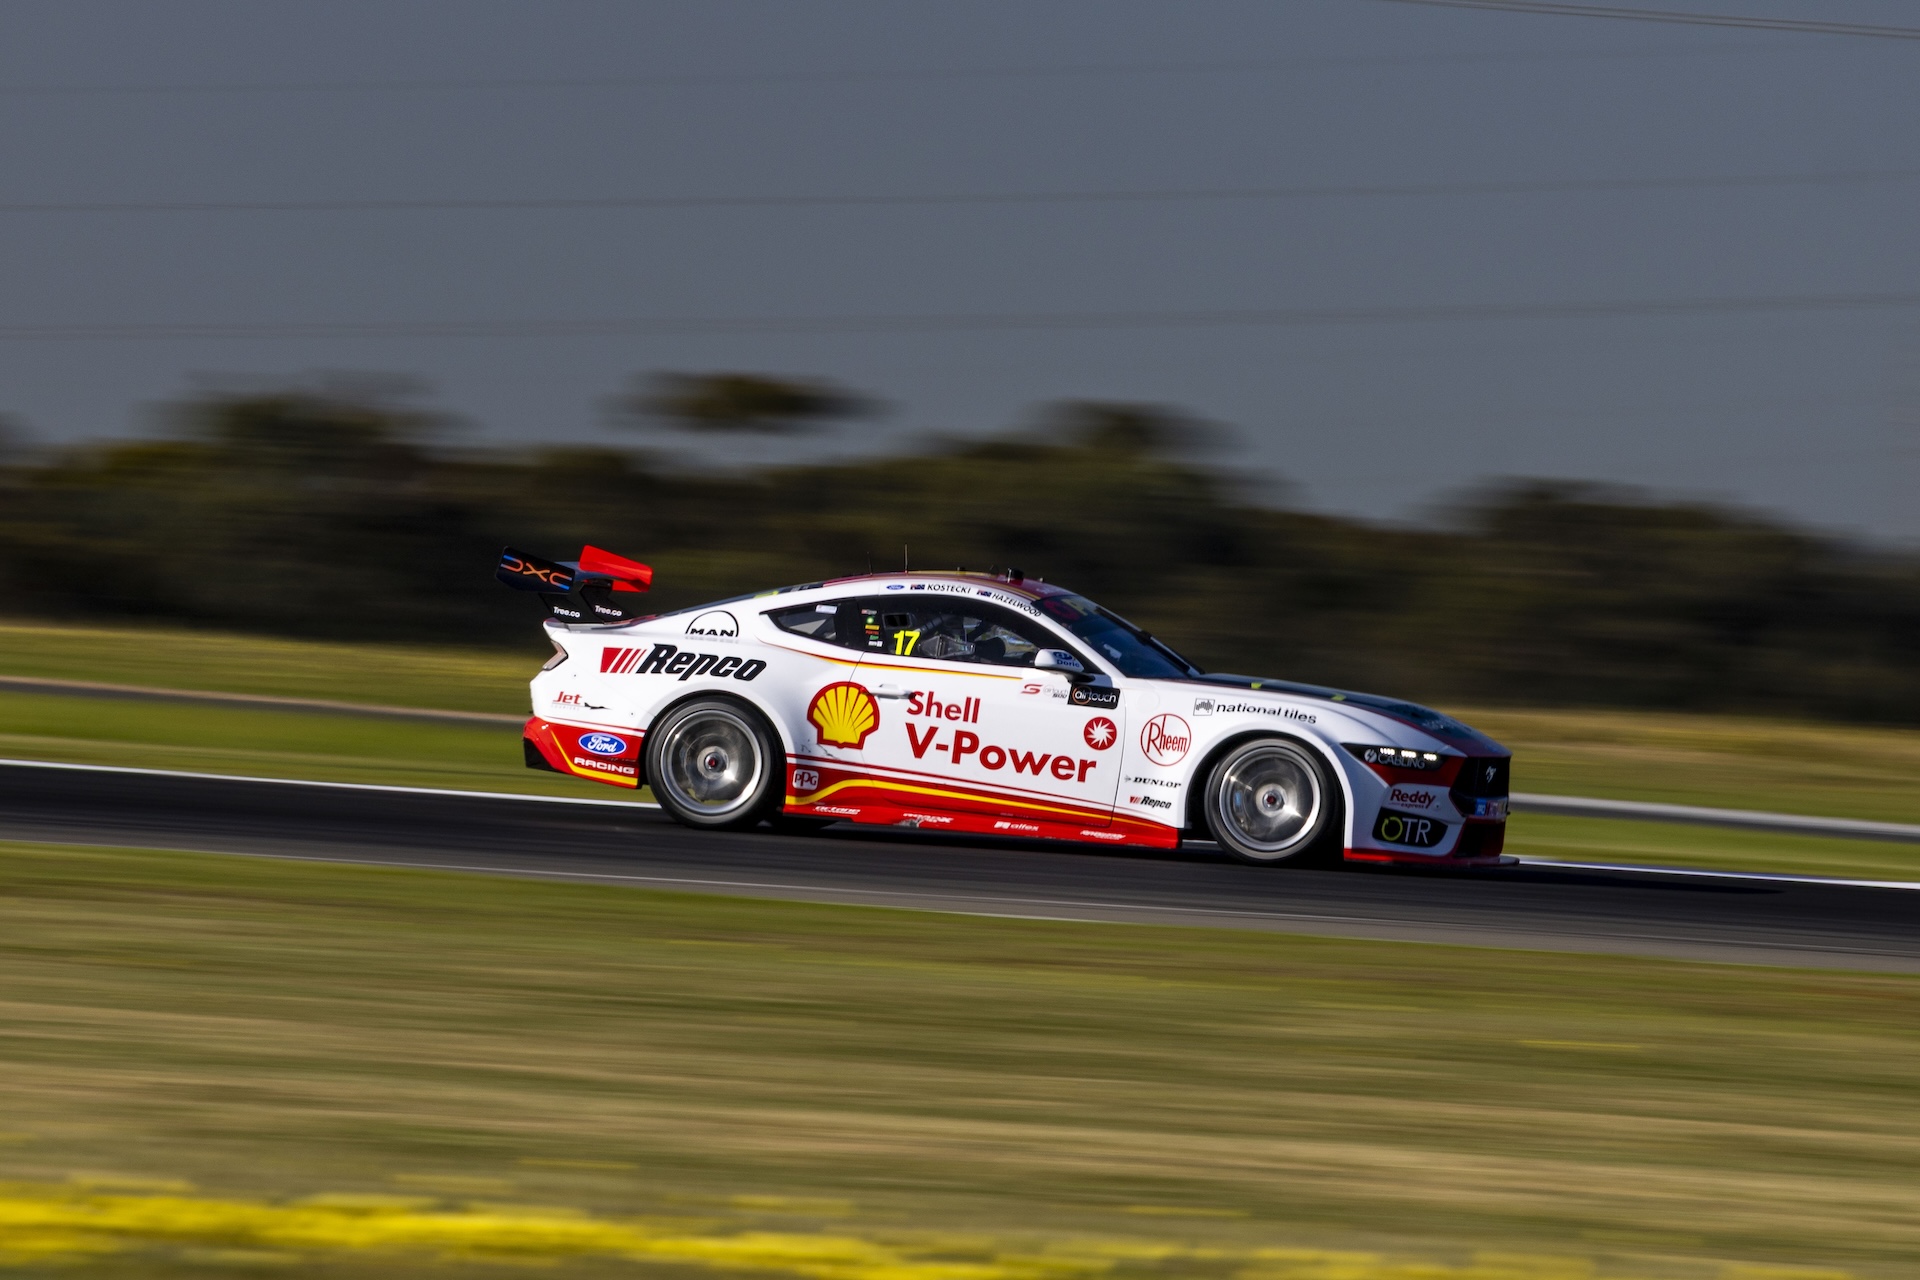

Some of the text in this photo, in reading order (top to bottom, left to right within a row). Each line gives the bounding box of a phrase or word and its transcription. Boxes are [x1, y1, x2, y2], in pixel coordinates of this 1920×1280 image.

[927, 583, 972, 594] KOSTECKI
[553, 606, 581, 618] Tree.co
[595, 605, 622, 617] Tree.co
[991, 593, 1042, 617] HAZELWOOD
[690, 628, 735, 637] MAN
[893, 630, 920, 656] 17
[635, 643, 767, 682] Repco
[553, 691, 582, 704] Jet
[1074, 689, 1117, 703] airtouch
[906, 690, 981, 724] Shell
[1216, 703, 1317, 724] national tiles
[587, 735, 619, 752] Ford
[1146, 714, 1188, 757] Rheem
[905, 722, 1097, 783] V-Power
[574, 757, 636, 774] RACING
[1377, 754, 1425, 769] CABLING
[1133, 776, 1182, 788] DUNLOP
[1140, 795, 1172, 809] Repco
[1389, 789, 1436, 809] Reddy
